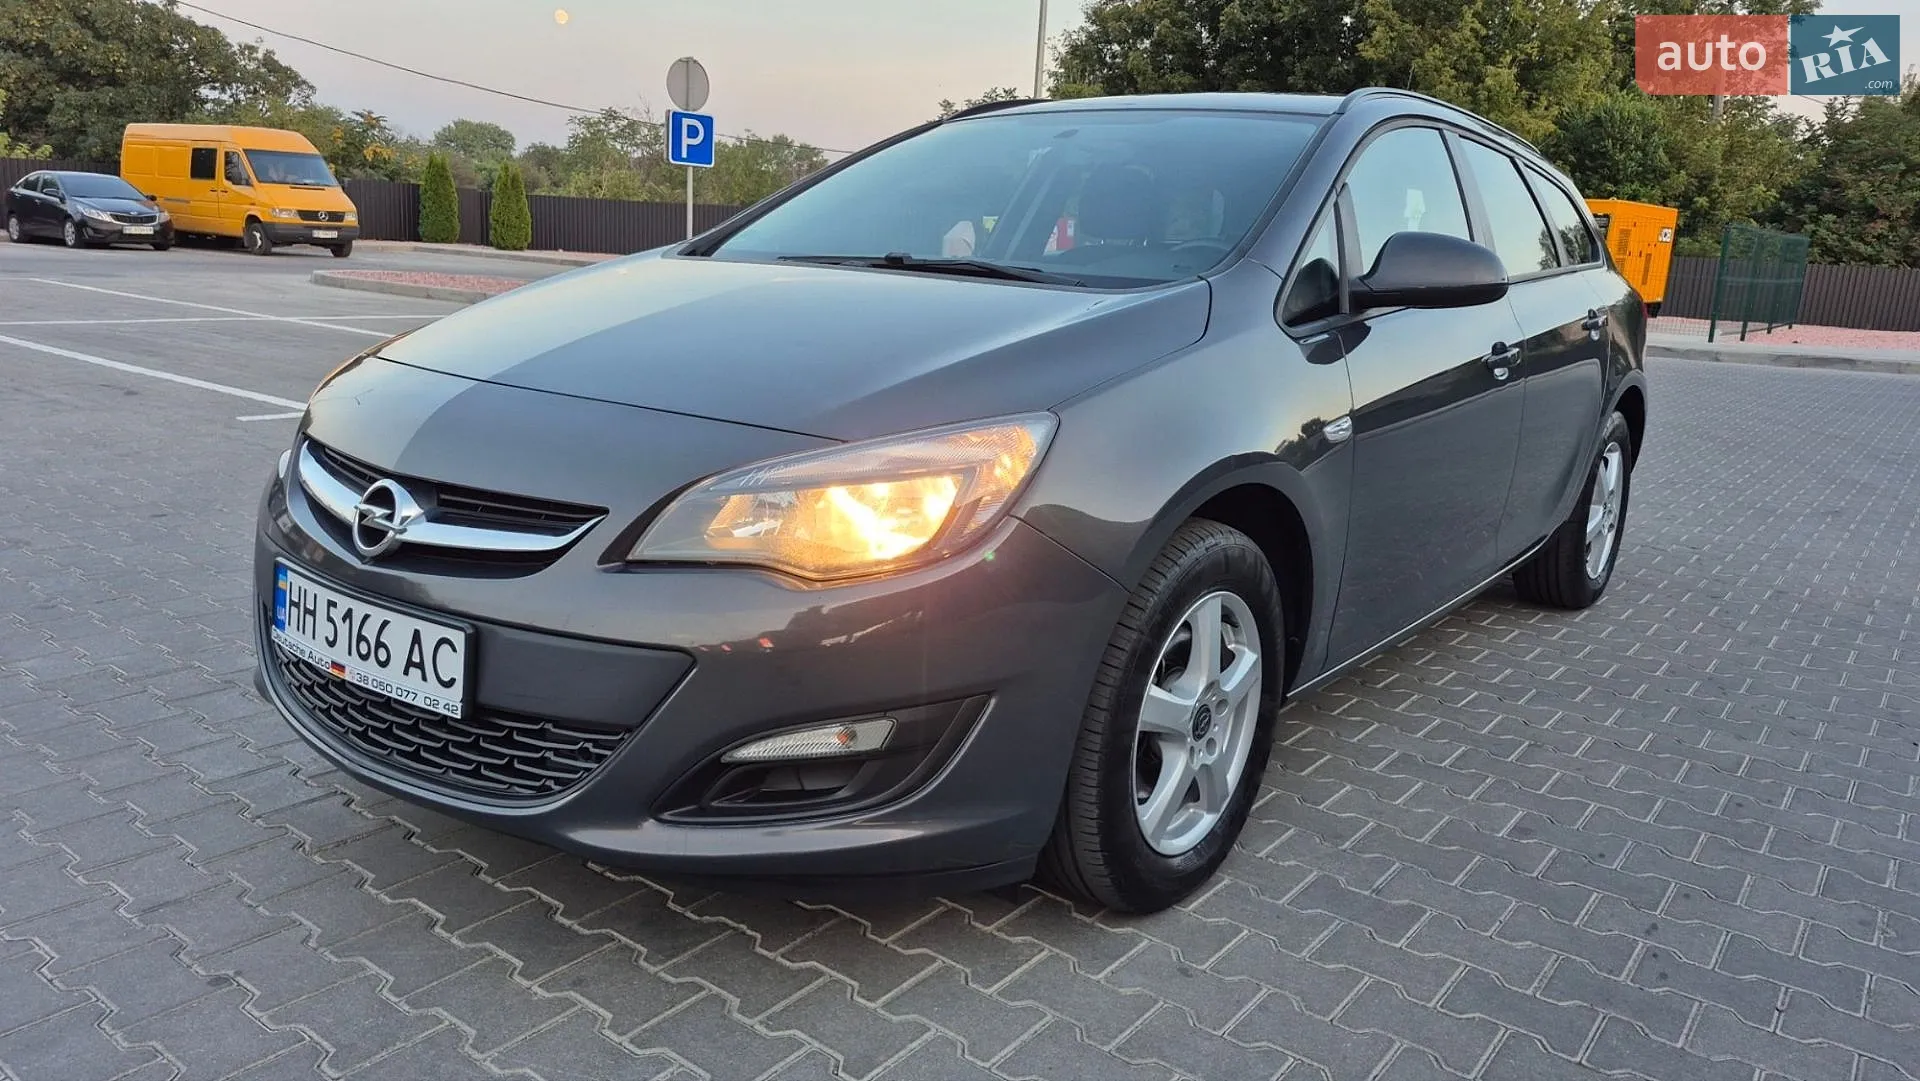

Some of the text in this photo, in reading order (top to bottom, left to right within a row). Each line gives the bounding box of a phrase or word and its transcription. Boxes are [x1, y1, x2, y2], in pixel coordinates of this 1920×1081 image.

[682, 118, 704, 158] P
[288, 581, 458, 689] HH 5166 AC
[308, 650, 331, 670] Auto
[371, 678, 393, 694] 050
[395, 686, 418, 702] 077
[423, 695, 440, 709] 02
[443, 702, 459, 715] 42
